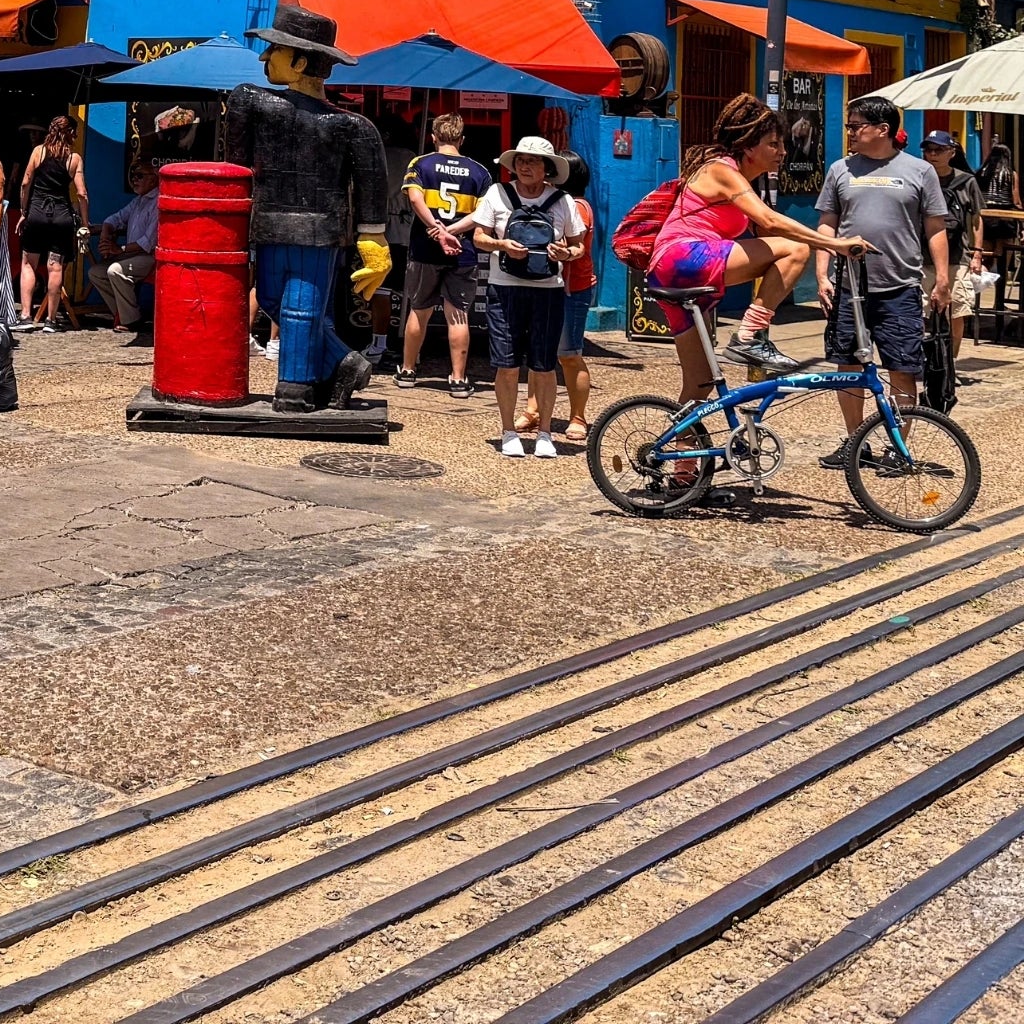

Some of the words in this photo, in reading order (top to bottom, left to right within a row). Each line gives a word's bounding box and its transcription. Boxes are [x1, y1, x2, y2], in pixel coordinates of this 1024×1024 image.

[793, 77, 811, 94] BAR
[946, 92, 1021, 106] Imperial
[435, 163, 470, 177] PAREDES
[438, 181, 460, 220] 5
[810, 375, 860, 383] OLMO
